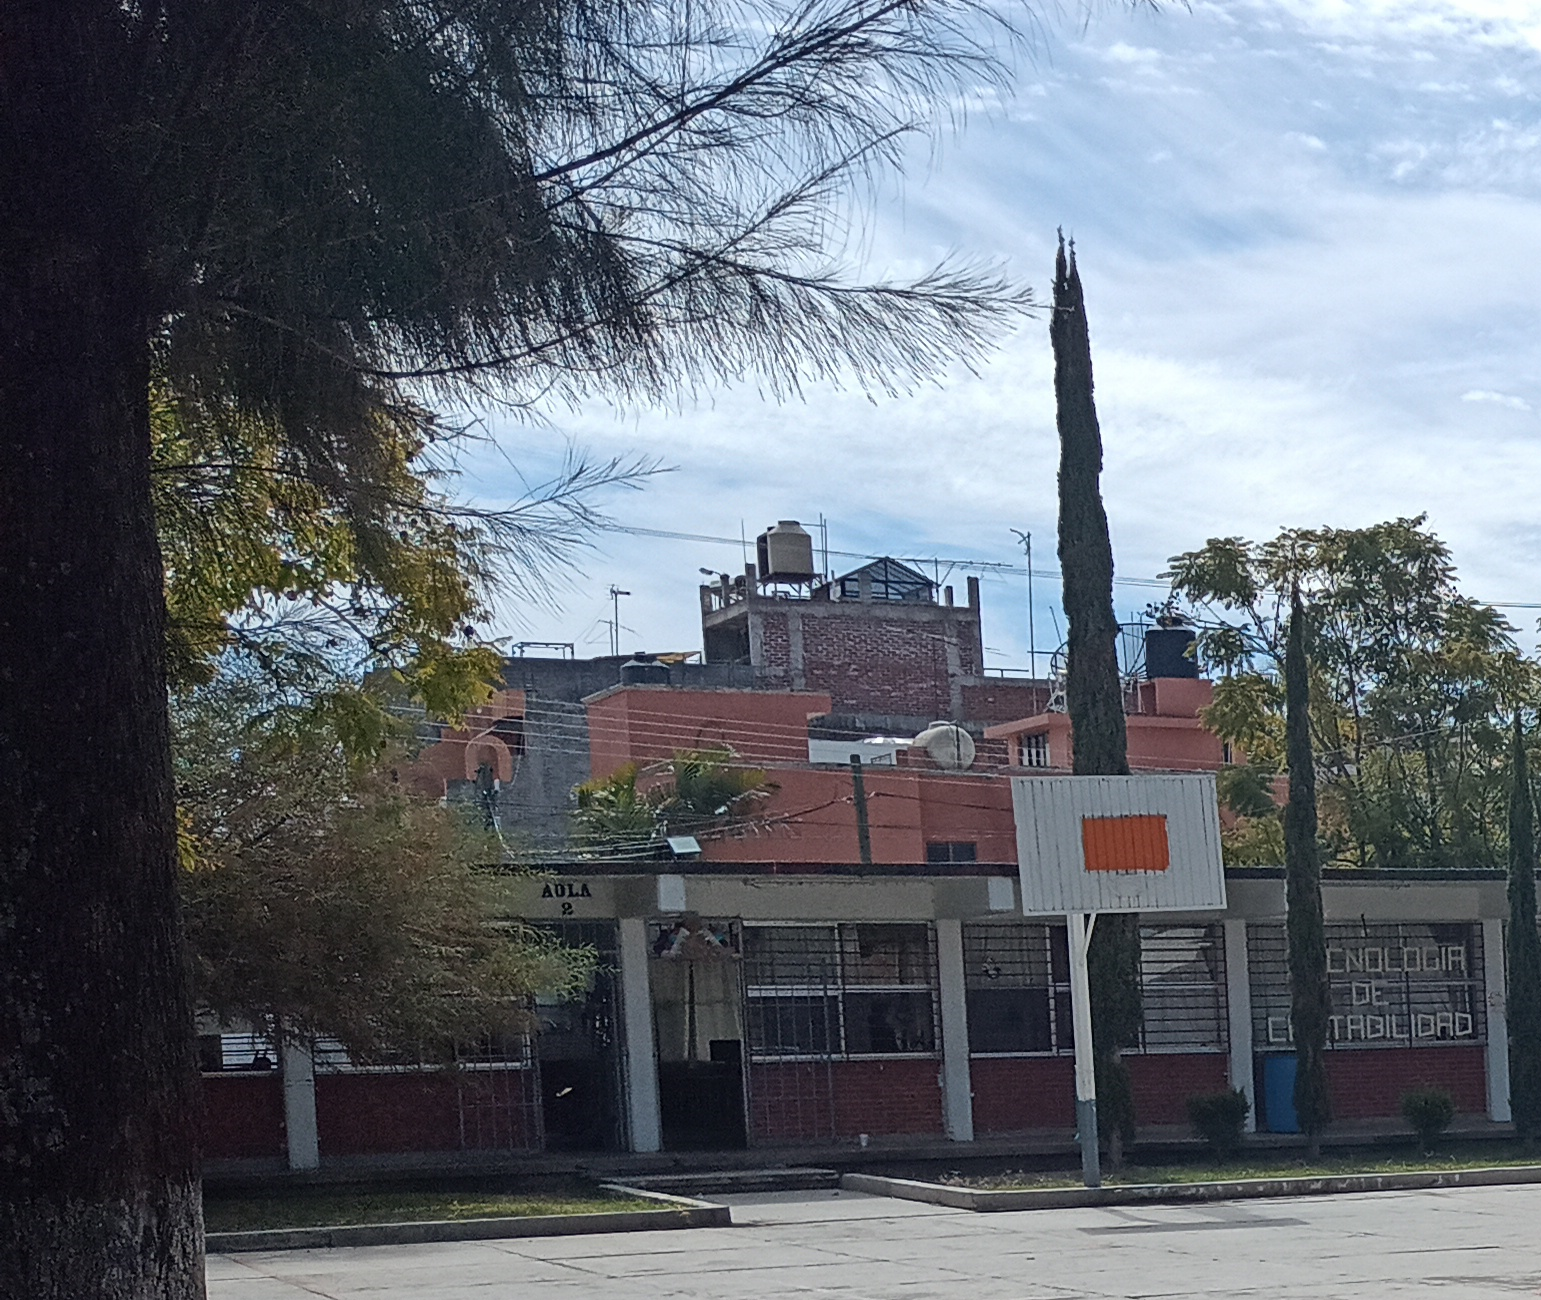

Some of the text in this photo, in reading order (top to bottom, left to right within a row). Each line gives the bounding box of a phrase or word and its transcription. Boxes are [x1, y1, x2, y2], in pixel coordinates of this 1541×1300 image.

[541, 883, 592, 898] AULA
[561, 902, 574, 916] 2
[1325, 946, 1465, 973] CNOLOGIA
[1352, 979, 1390, 1006] DE
[1267, 1011, 1473, 1042] CTABILIDAD
